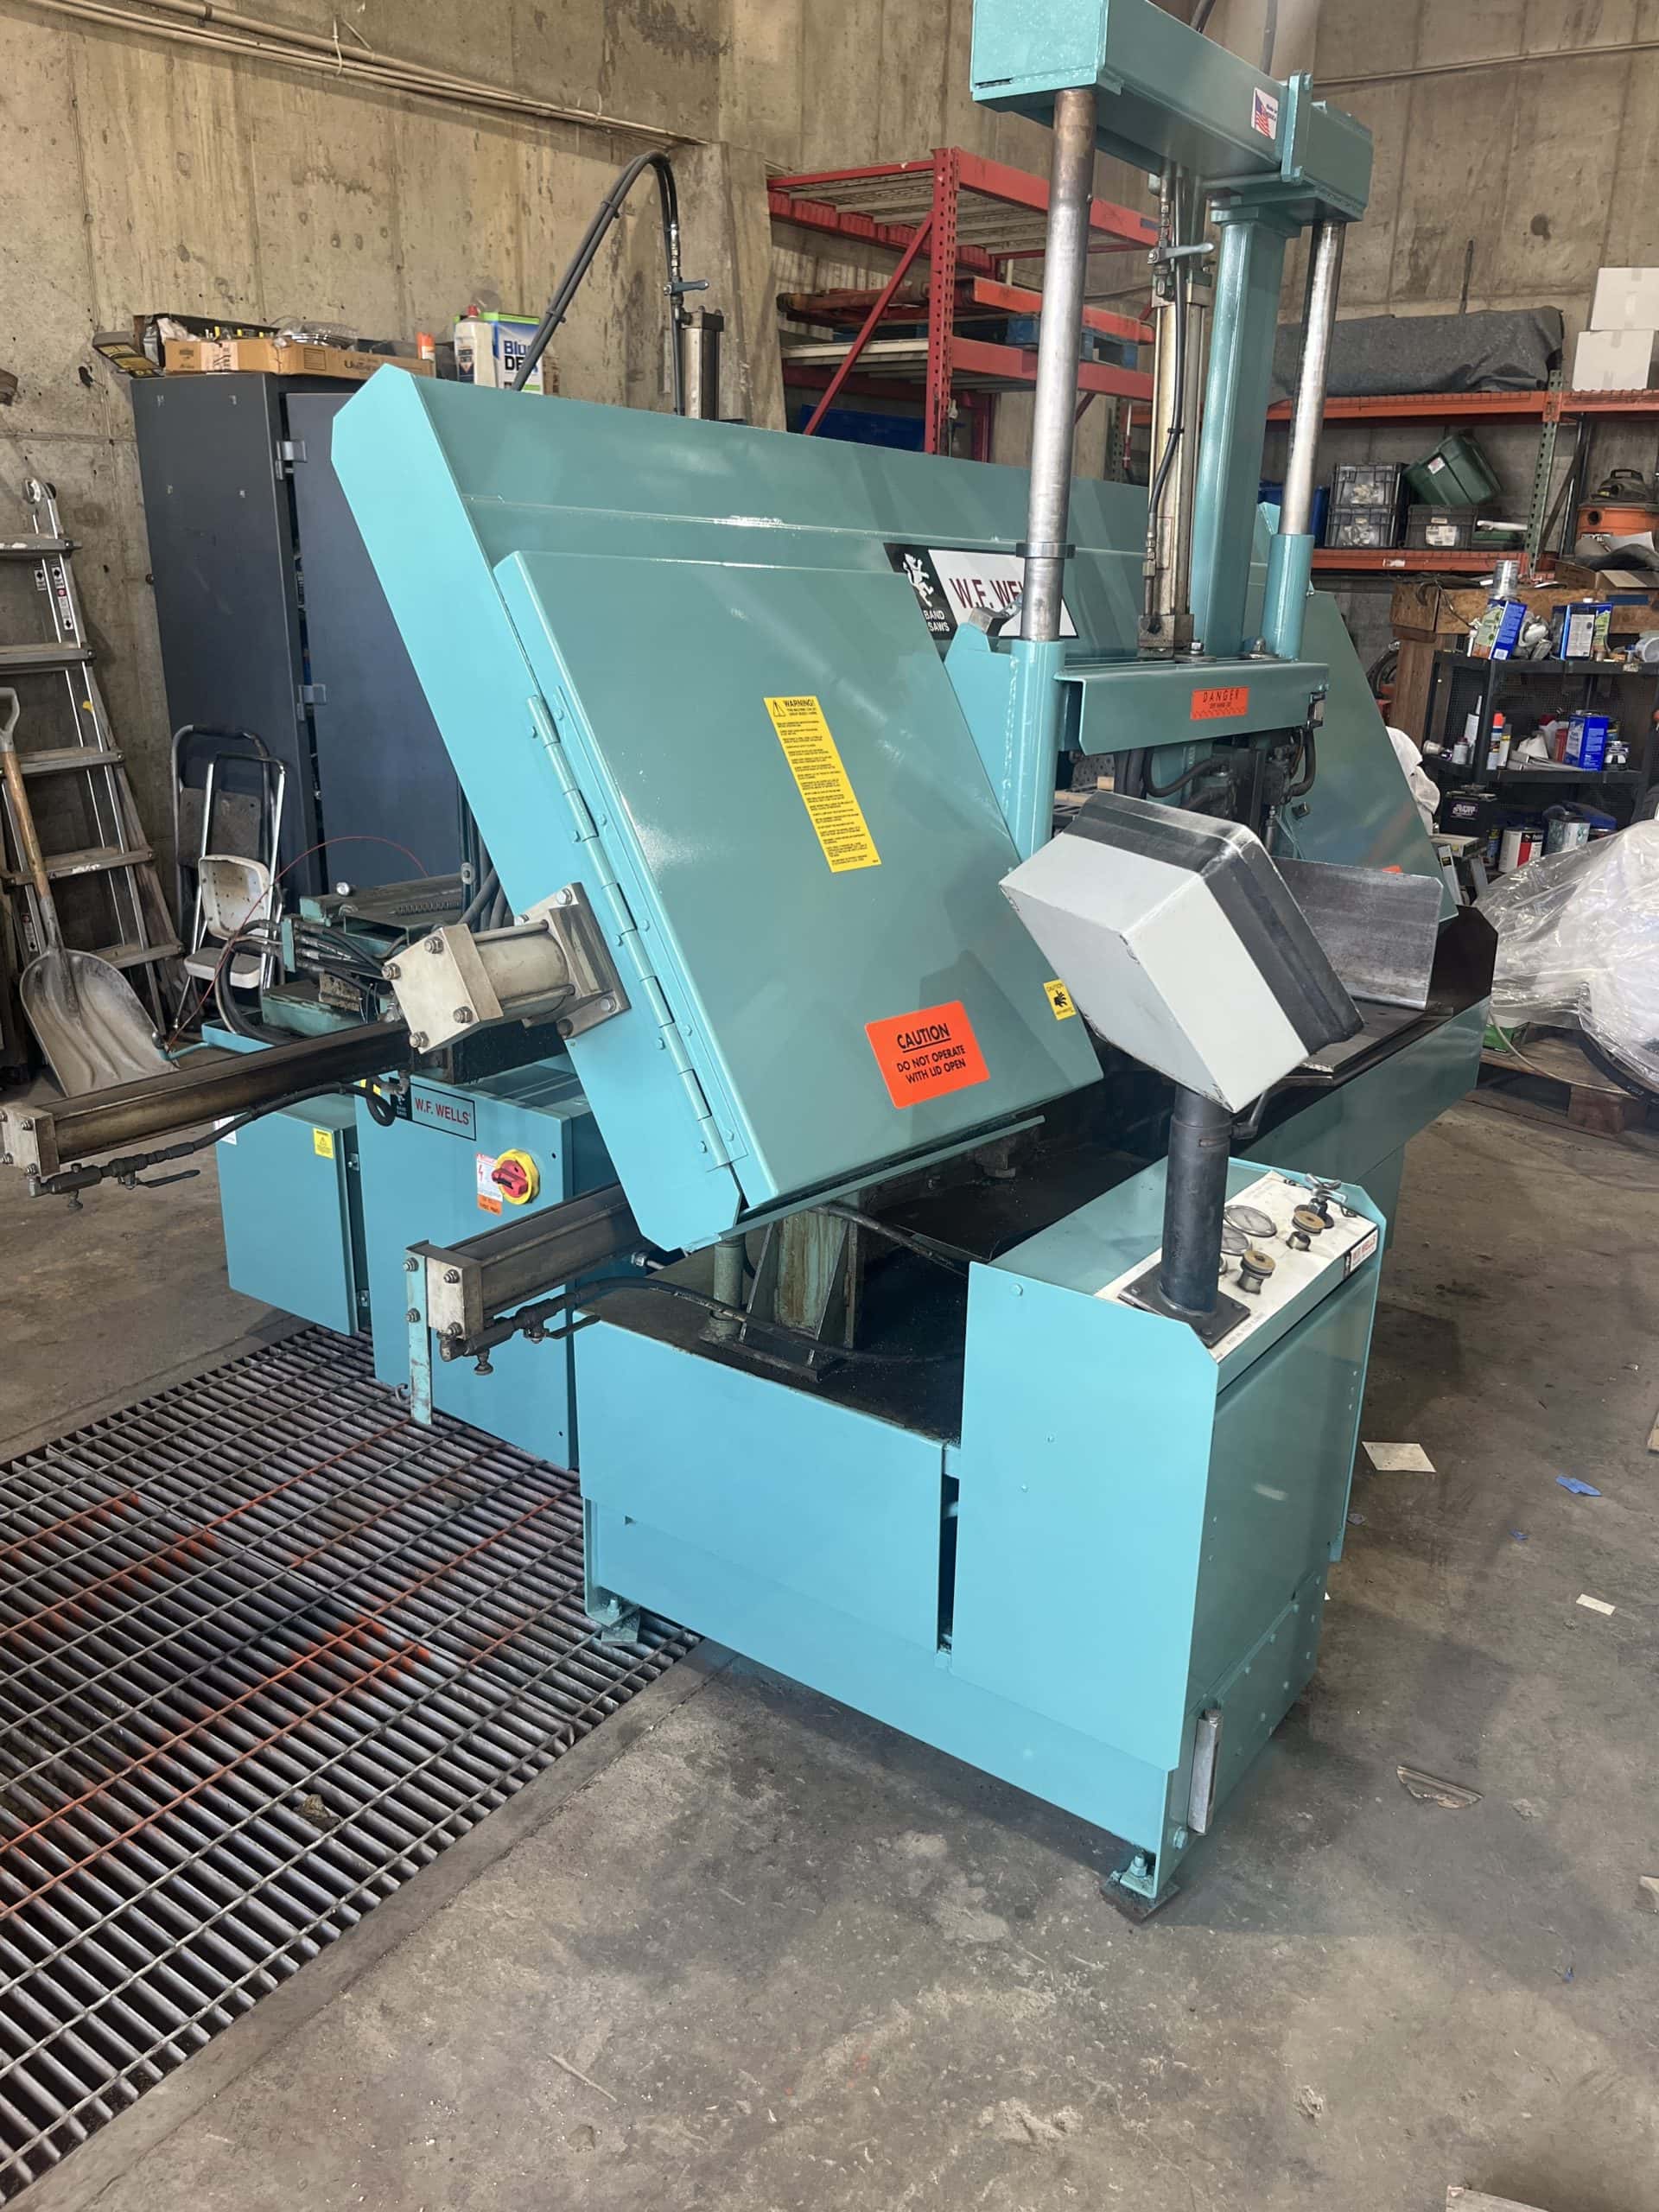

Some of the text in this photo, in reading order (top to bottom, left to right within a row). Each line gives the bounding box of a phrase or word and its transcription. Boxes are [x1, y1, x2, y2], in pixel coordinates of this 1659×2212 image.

[504, 340, 528, 355] Blu
[505, 355, 526, 371] DE
[923, 610, 945, 620] BAND
[927, 621, 950, 632] SAWS
[1202, 689, 1240, 703] DANGER
[897, 1022, 950, 1049] CAUTION
[896, 1045, 966, 1073] DO NOT OPERATE
[906, 1058, 966, 1084] WITH LID OPEN
[415, 1097, 434, 1115] W.F.
